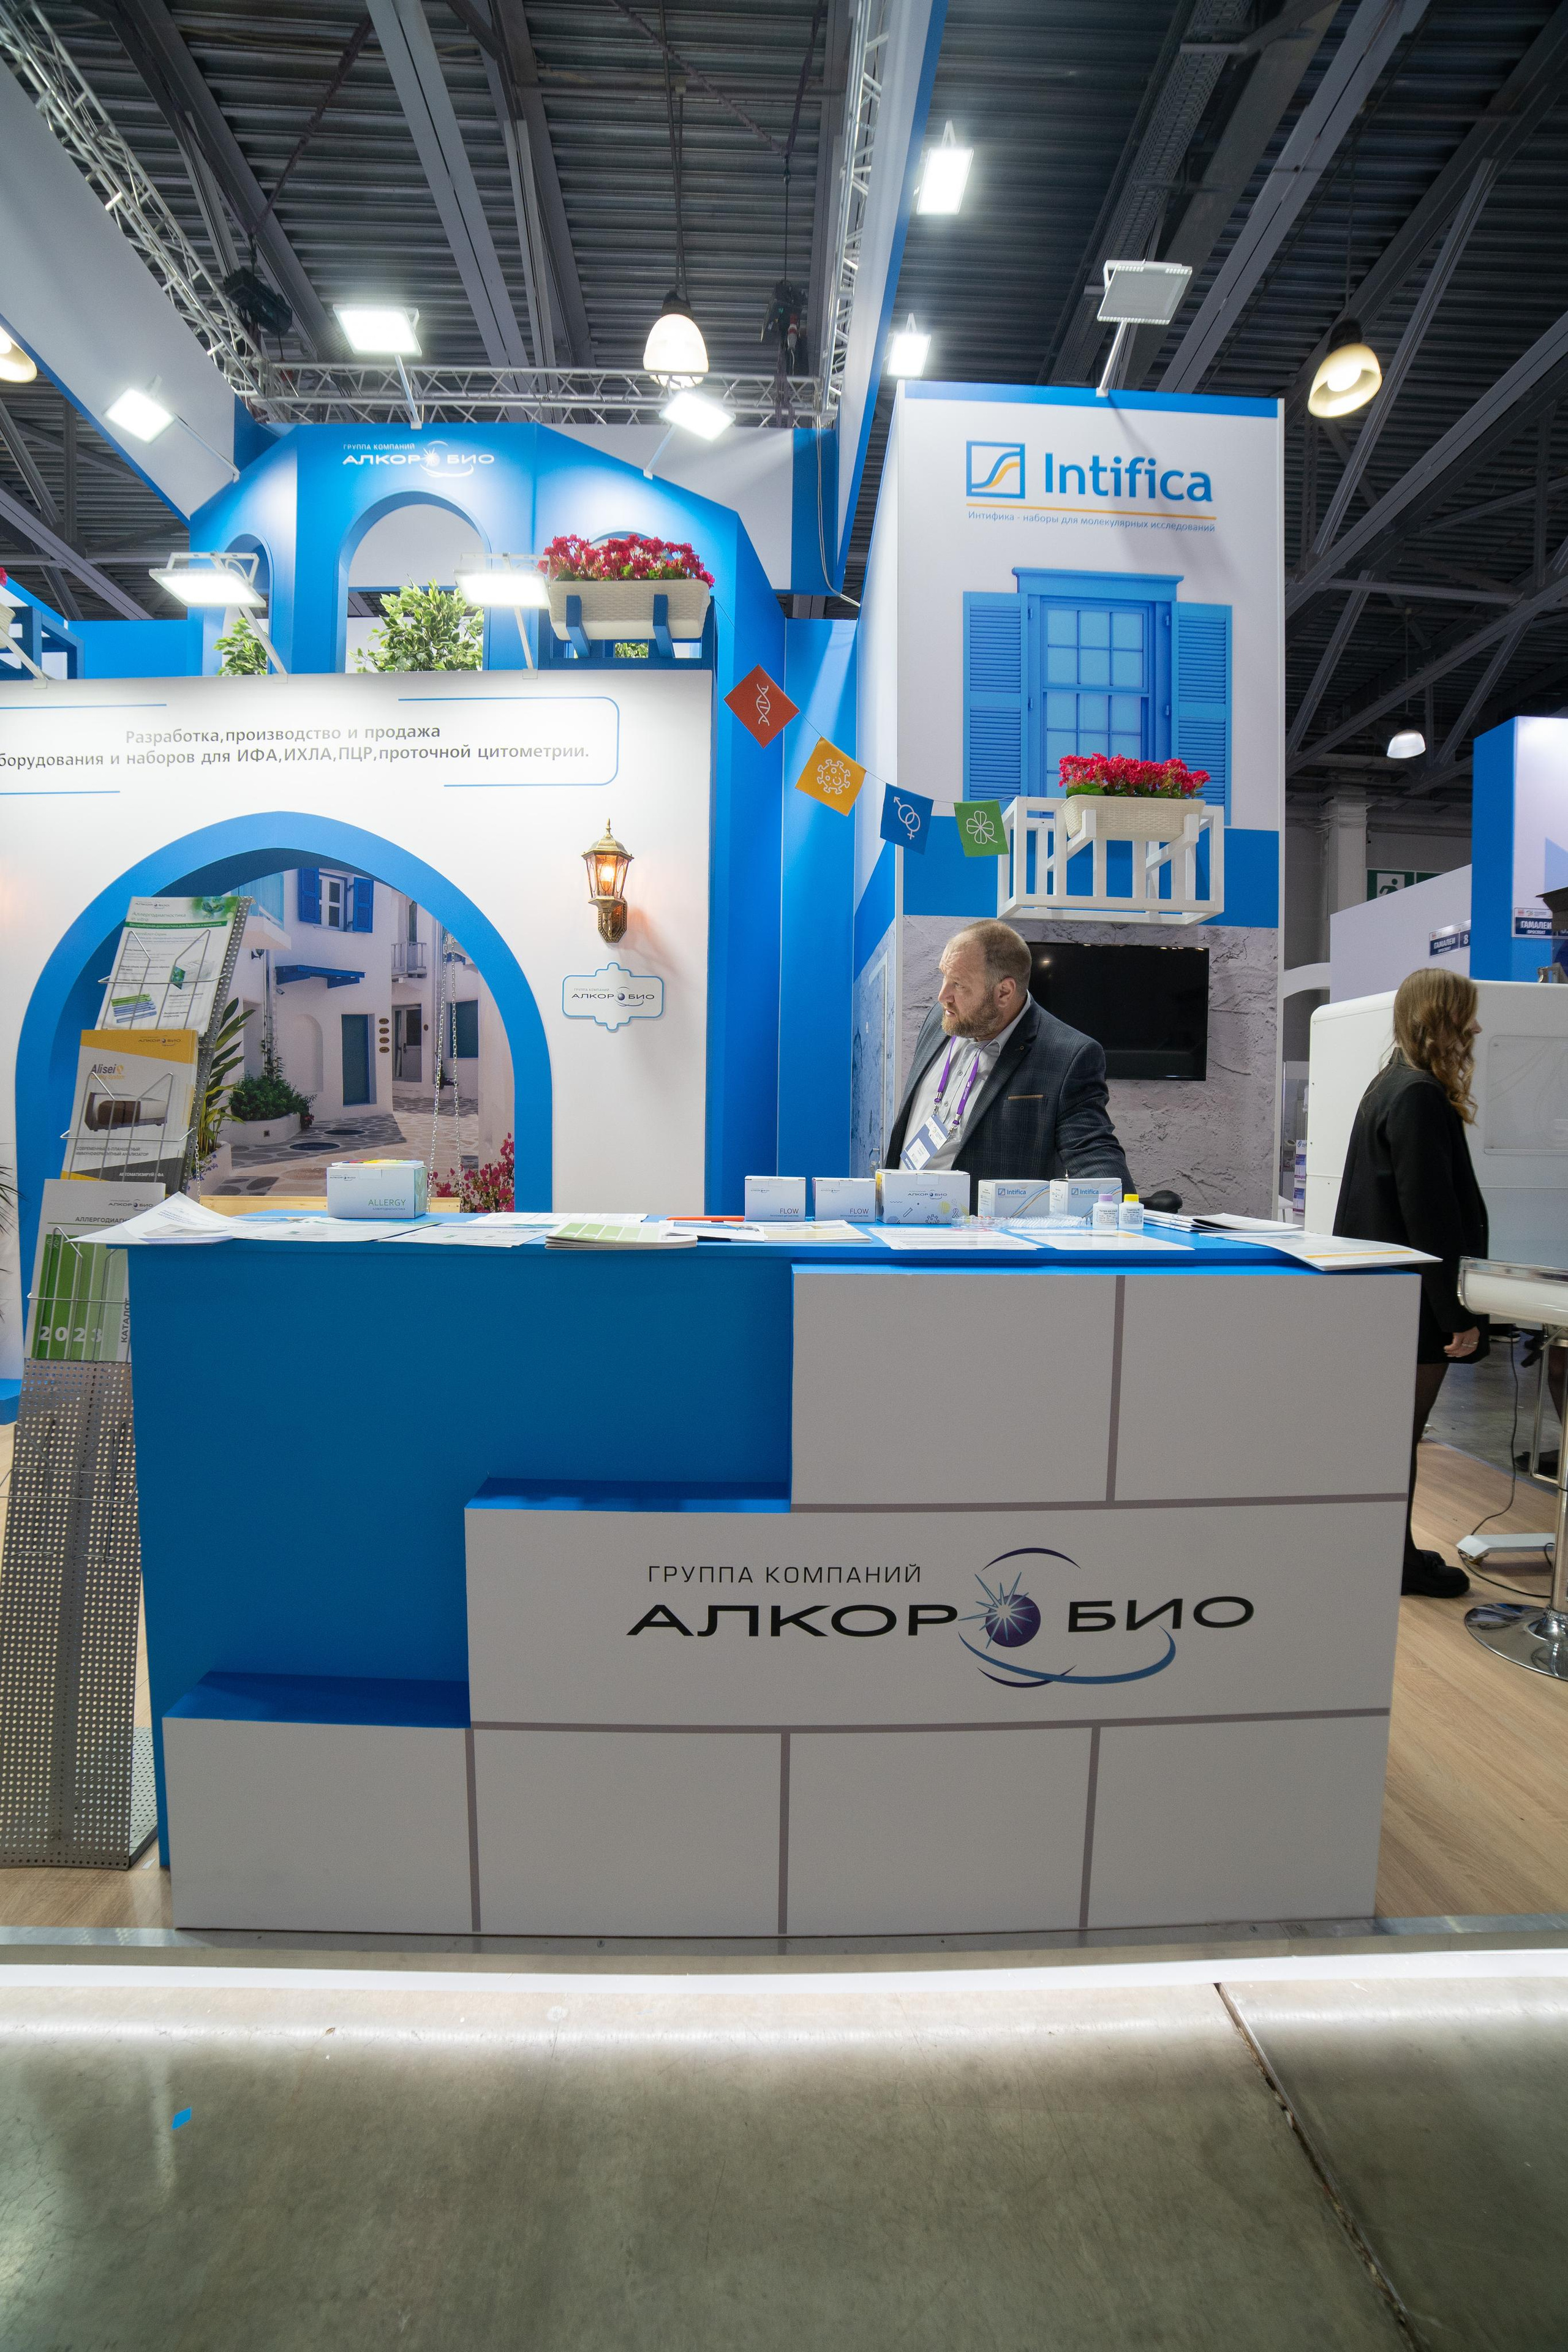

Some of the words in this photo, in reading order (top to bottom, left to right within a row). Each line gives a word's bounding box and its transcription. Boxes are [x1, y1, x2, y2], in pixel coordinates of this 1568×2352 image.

[342, 454, 420, 465] АЛКОР
[447, 454, 495, 465] БИО
[1045, 452, 1213, 502] Intifica
[968, 511, 1014, 522] Интифика
[1023, 513, 1058, 524] наборы
[1081, 518, 1148, 529] молекулярных
[1151, 521, 1216, 532] исследований
[348, 729, 357, 739] и
[365, 726, 440, 742] продажа
[111, 755, 119, 764] и
[127, 751, 195, 766] наборов
[201, 752, 230, 765] для
[478, 745, 589, 761] цитометрии.
[1463, 934, 1469, 944] 8
[91, 1064, 117, 1074] Alisei
[39, 1325, 103, 1343] 2023
[648, 1566, 753, 1583] ГРУППА
[765, 1563, 921, 1583] КОМПАНИЙ
[626, 1604, 959, 1637] АЛКОР
[1068, 1596, 1254, 1632] БИО
